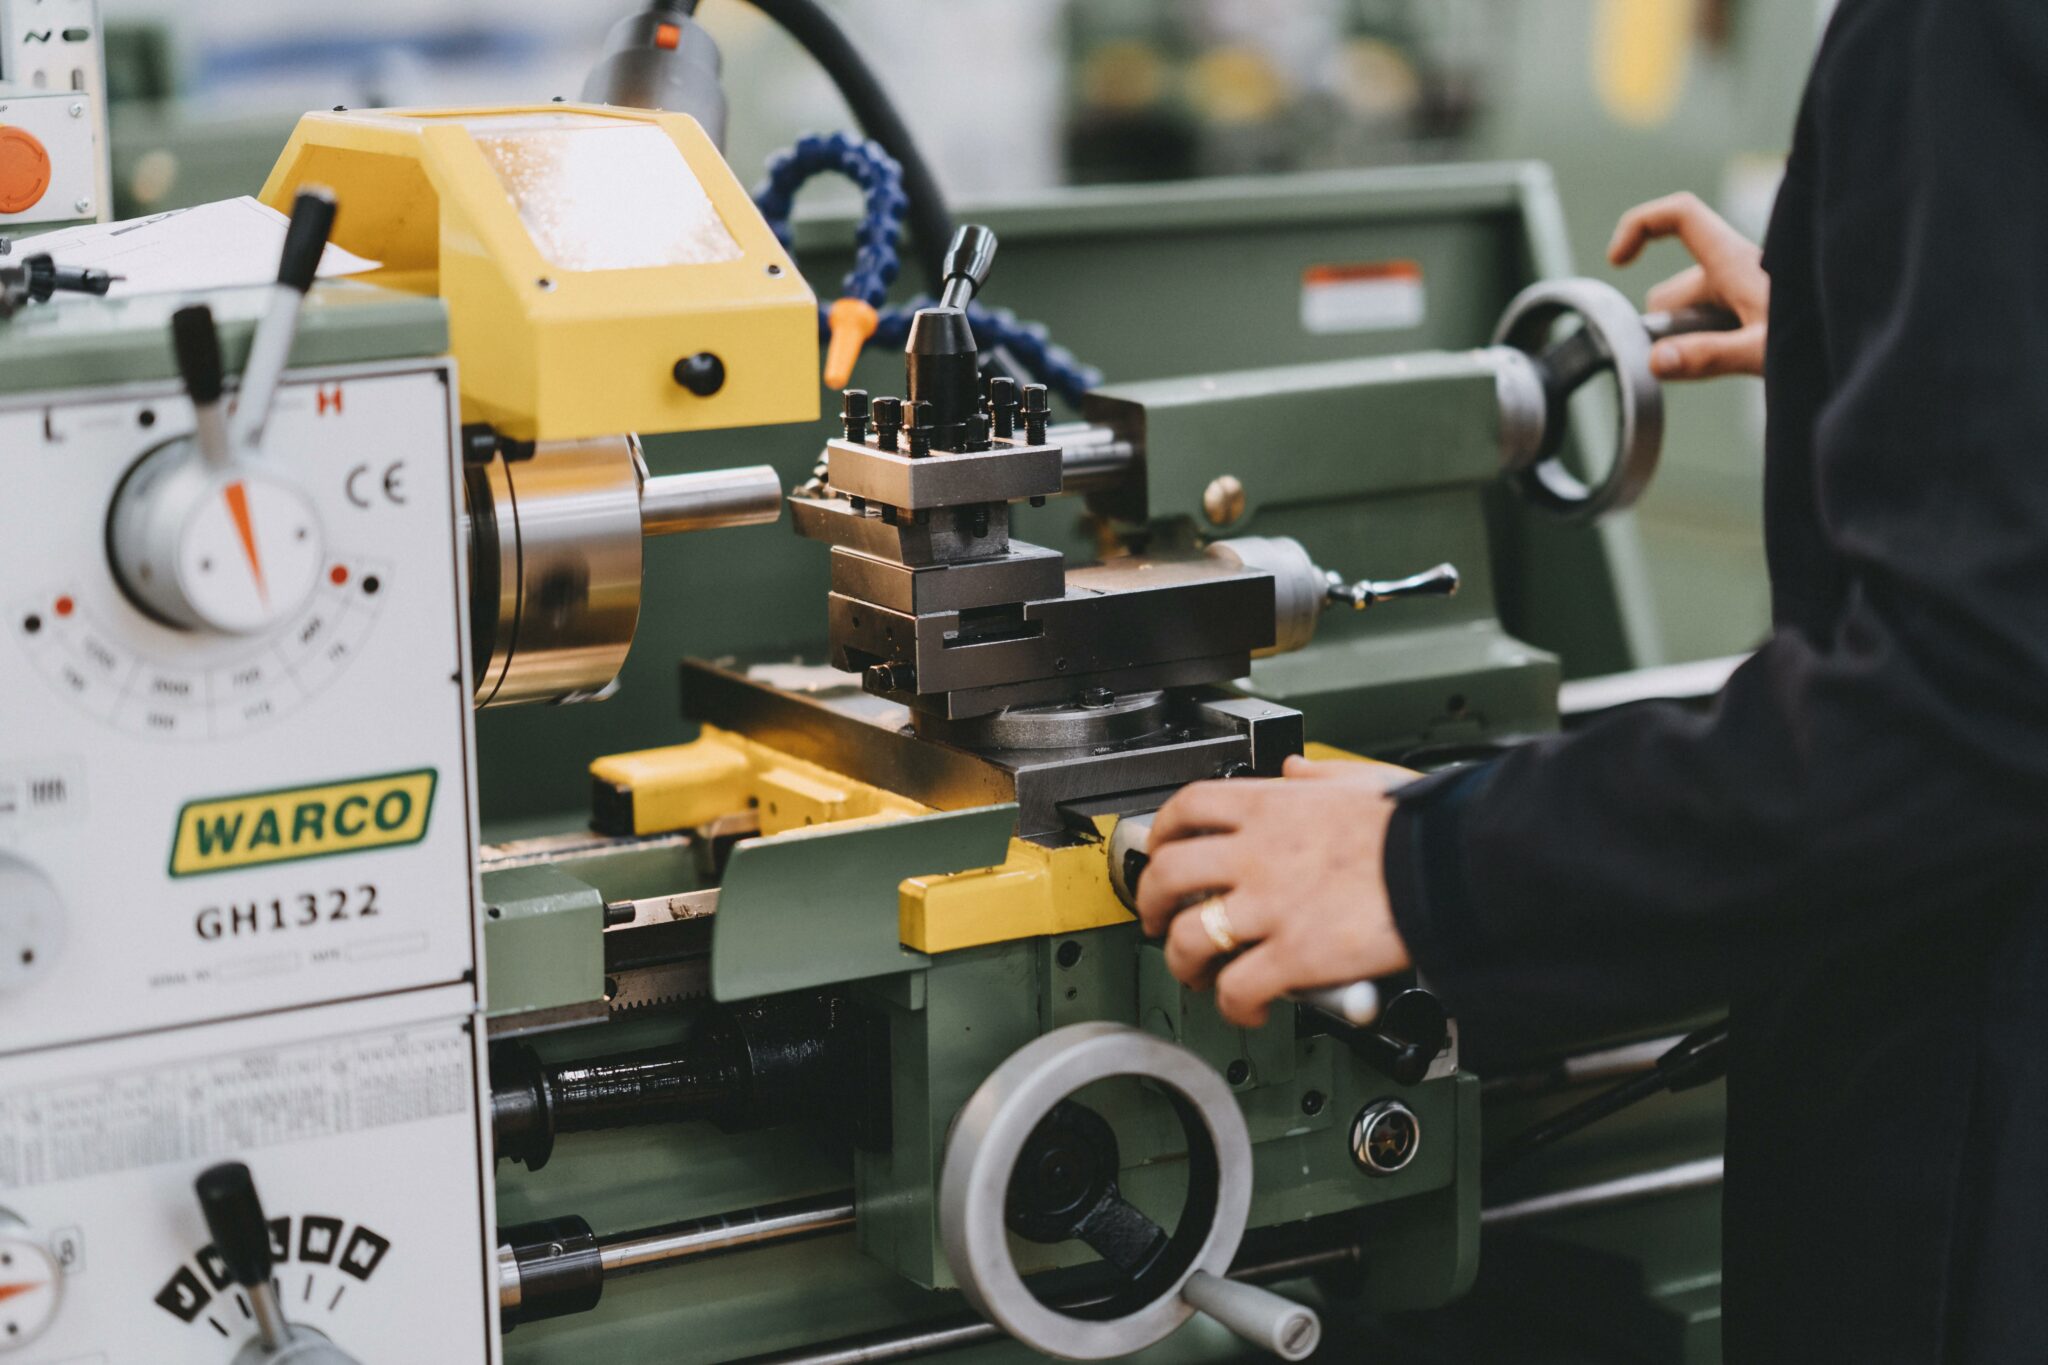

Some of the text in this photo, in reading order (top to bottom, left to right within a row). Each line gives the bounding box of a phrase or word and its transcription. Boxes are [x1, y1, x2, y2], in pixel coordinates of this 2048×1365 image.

[316, 384, 344, 416] H
[196, 789, 413, 857] WARCO
[195, 884, 380, 941] GH1322
